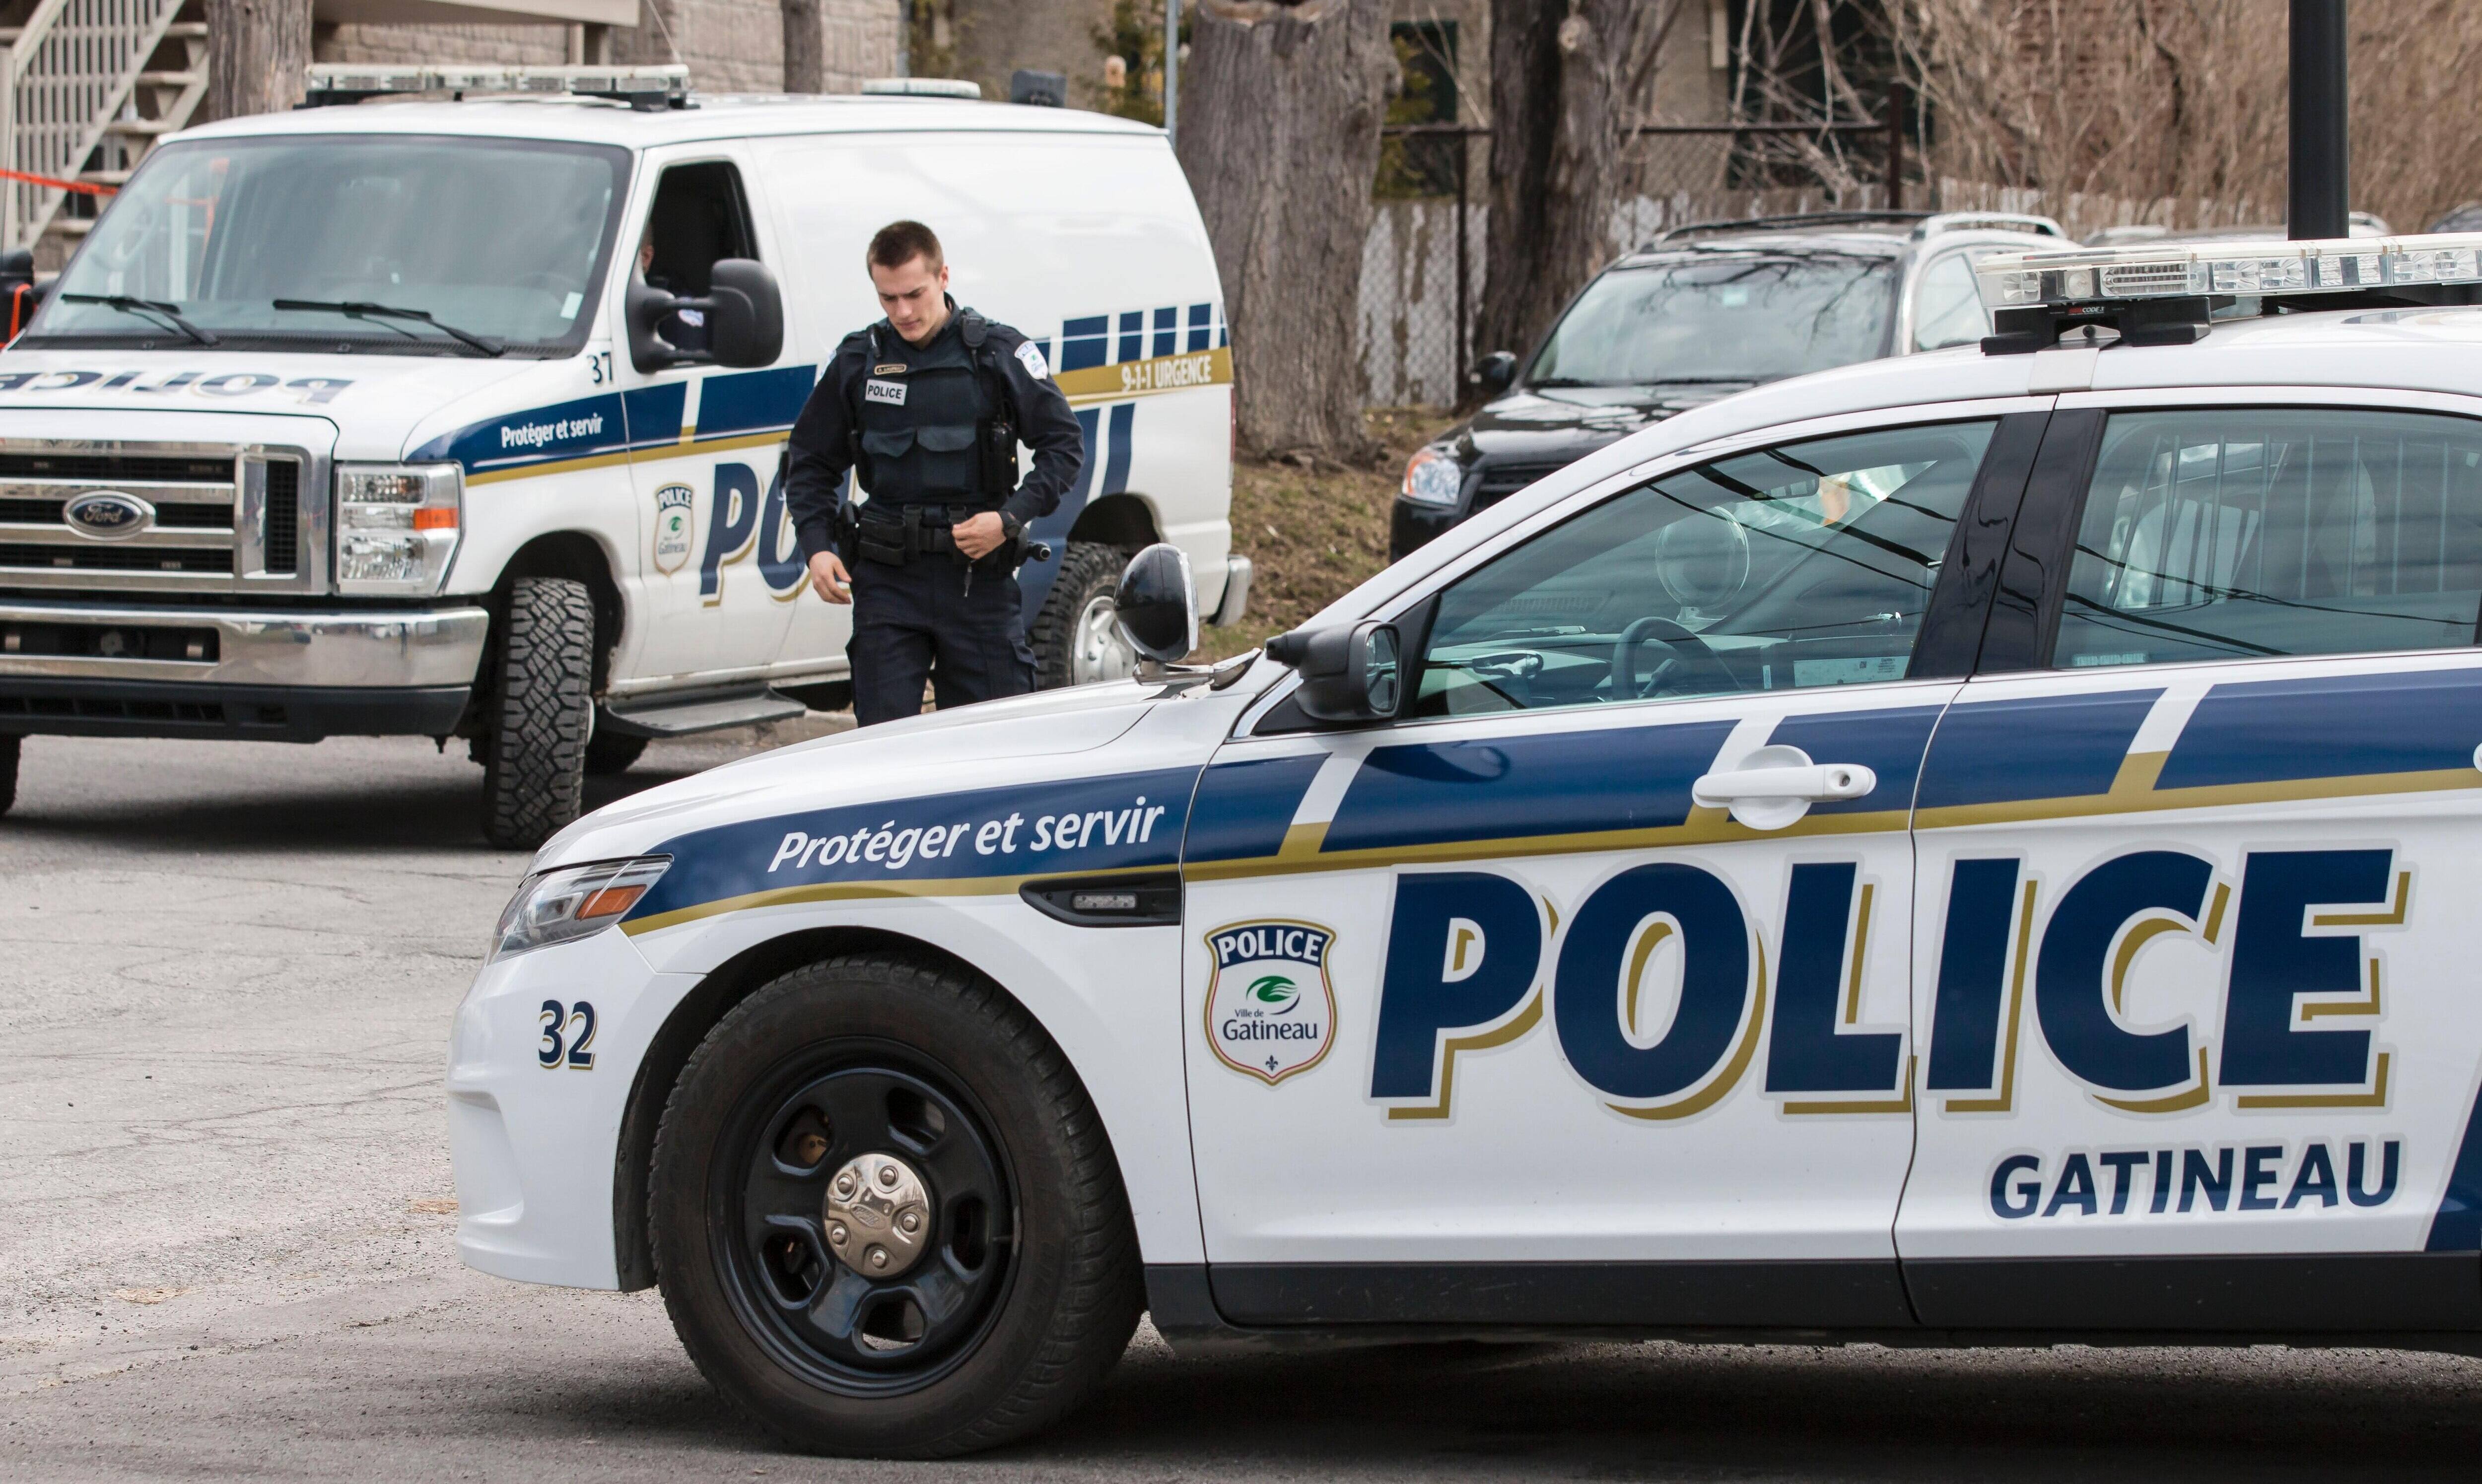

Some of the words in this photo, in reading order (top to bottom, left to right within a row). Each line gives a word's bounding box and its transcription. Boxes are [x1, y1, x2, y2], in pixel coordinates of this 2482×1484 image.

[587, 350, 613, 385] 37
[1121, 363, 1151, 394] 9-1-1
[1155, 355, 1212, 389] URGENCE
[868, 385, 902, 399] POLICE
[501, 422, 555, 448] Protéger
[555, 419, 569, 439] et
[570, 412, 604, 437] servir
[84, 502, 124, 523] Ford
[658, 487, 692, 510] POLICE
[767, 819, 970, 872] Protéger
[975, 812, 1024, 853] et
[1030, 796, 1165, 852] servir
[1217, 929, 1323, 964] POLICE
[1369, 849, 2411, 1122] POLICE
[1223, 1019, 1318, 1040] Gatineau
[1235, 1009, 1252, 1017] Ville
[1254, 1009, 1264, 1017] de
[539, 999, 598, 1071] 32
[1990, 1140, 2401, 1218] GATINEAU
